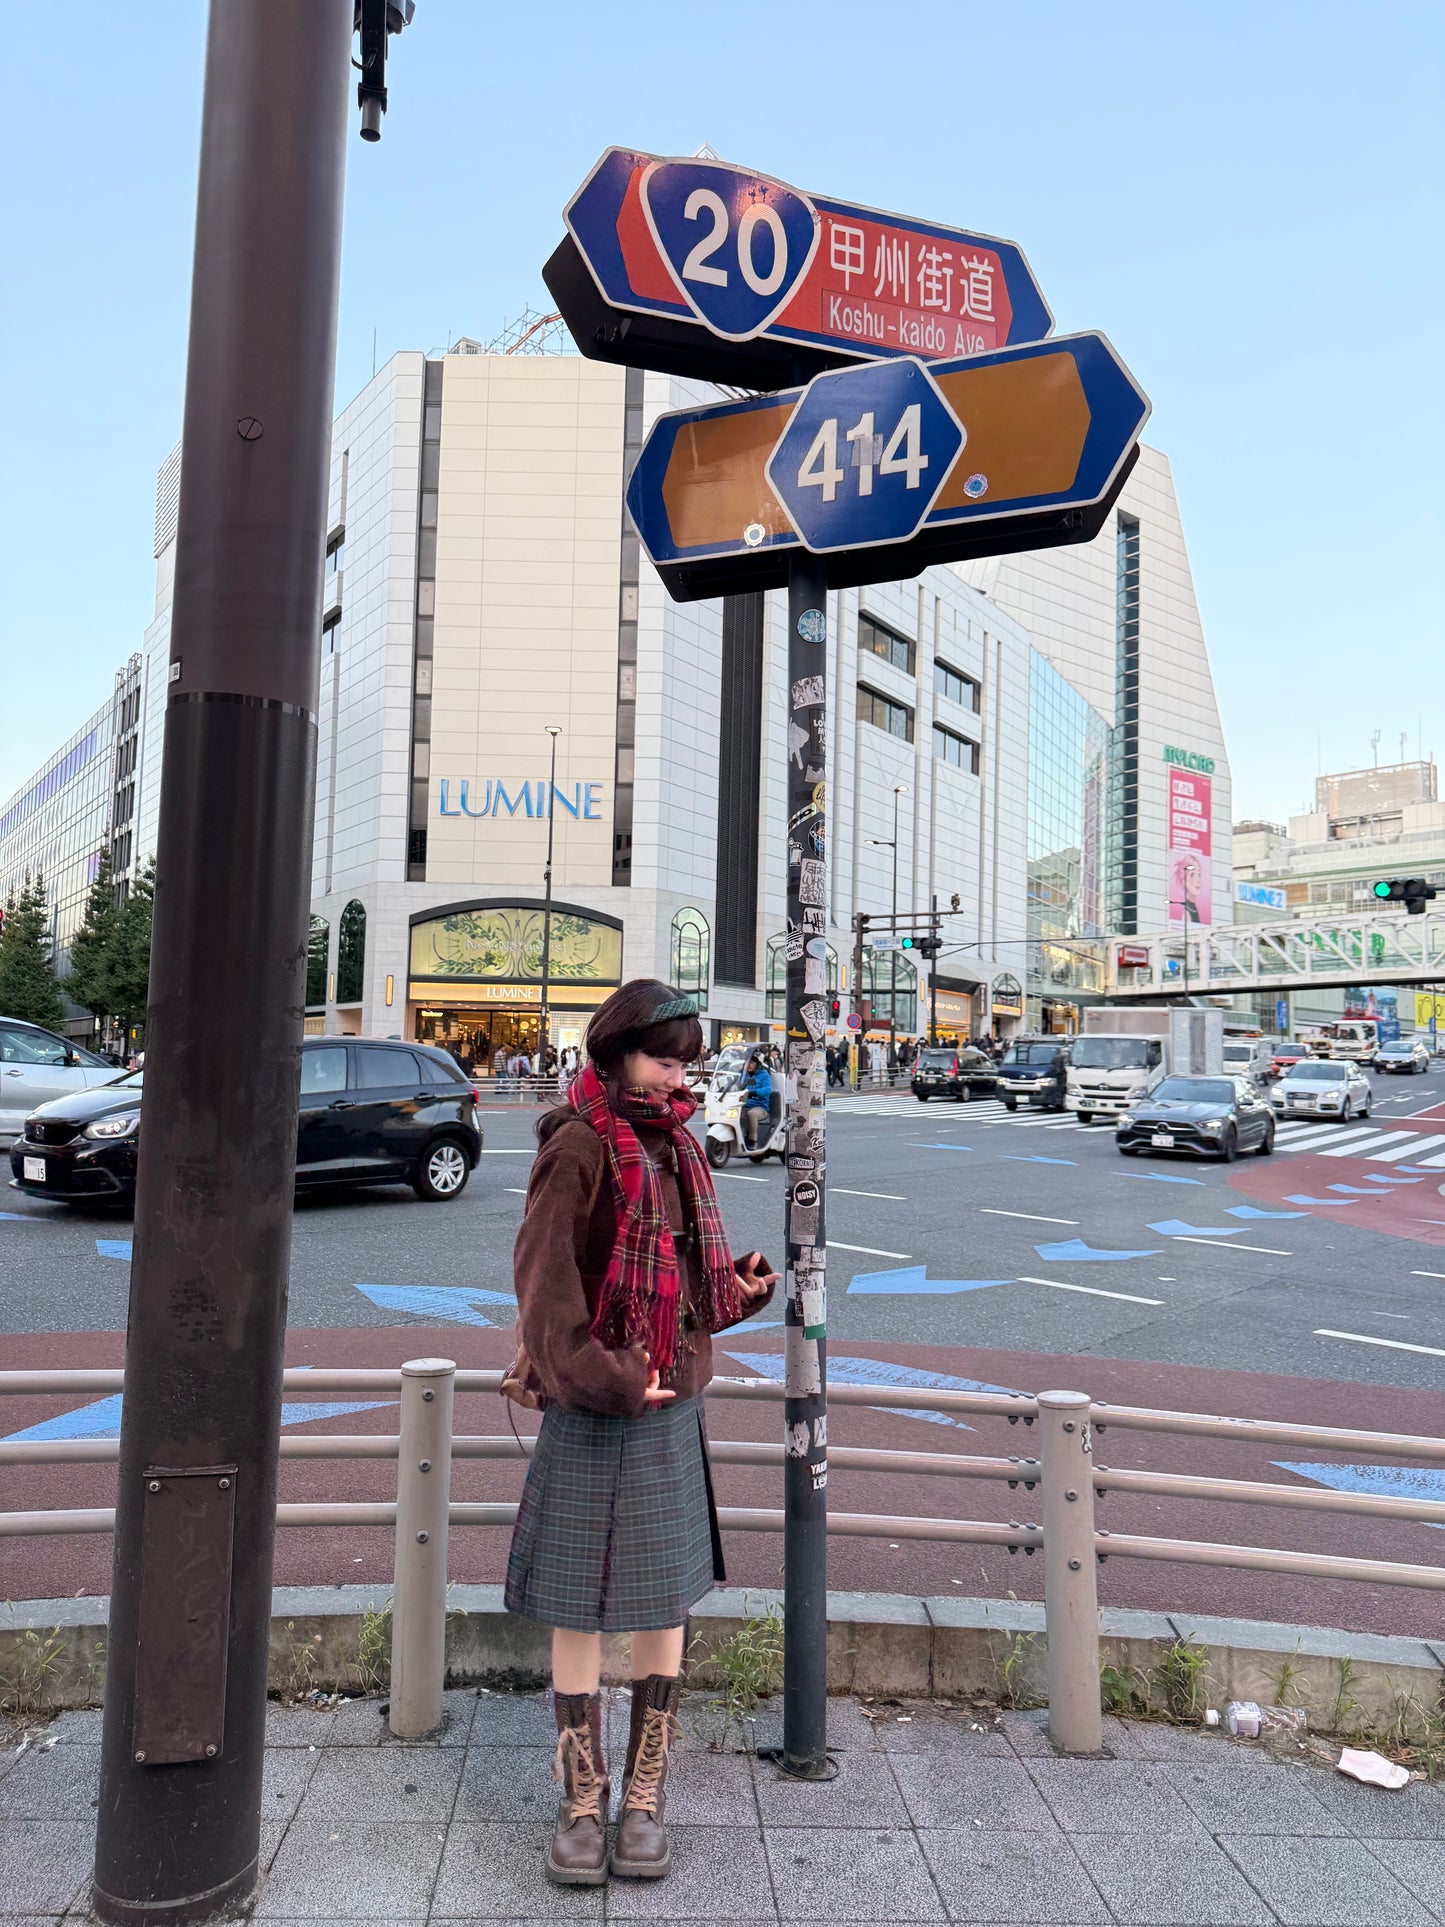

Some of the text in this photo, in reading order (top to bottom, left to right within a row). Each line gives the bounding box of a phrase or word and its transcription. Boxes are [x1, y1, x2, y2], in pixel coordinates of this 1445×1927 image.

[682, 188, 788, 296] 20
[829, 223, 996, 322] 甲州街道
[829, 295, 947, 352] Koshu-kaido
[797, 404, 929, 502] 414
[440, 778, 603, 820] LUMINE
[1239, 883, 1283, 908] LUMINE 2
[486, 987, 534, 999] LUMINE
[796, 1189, 816, 1201] NOISY
